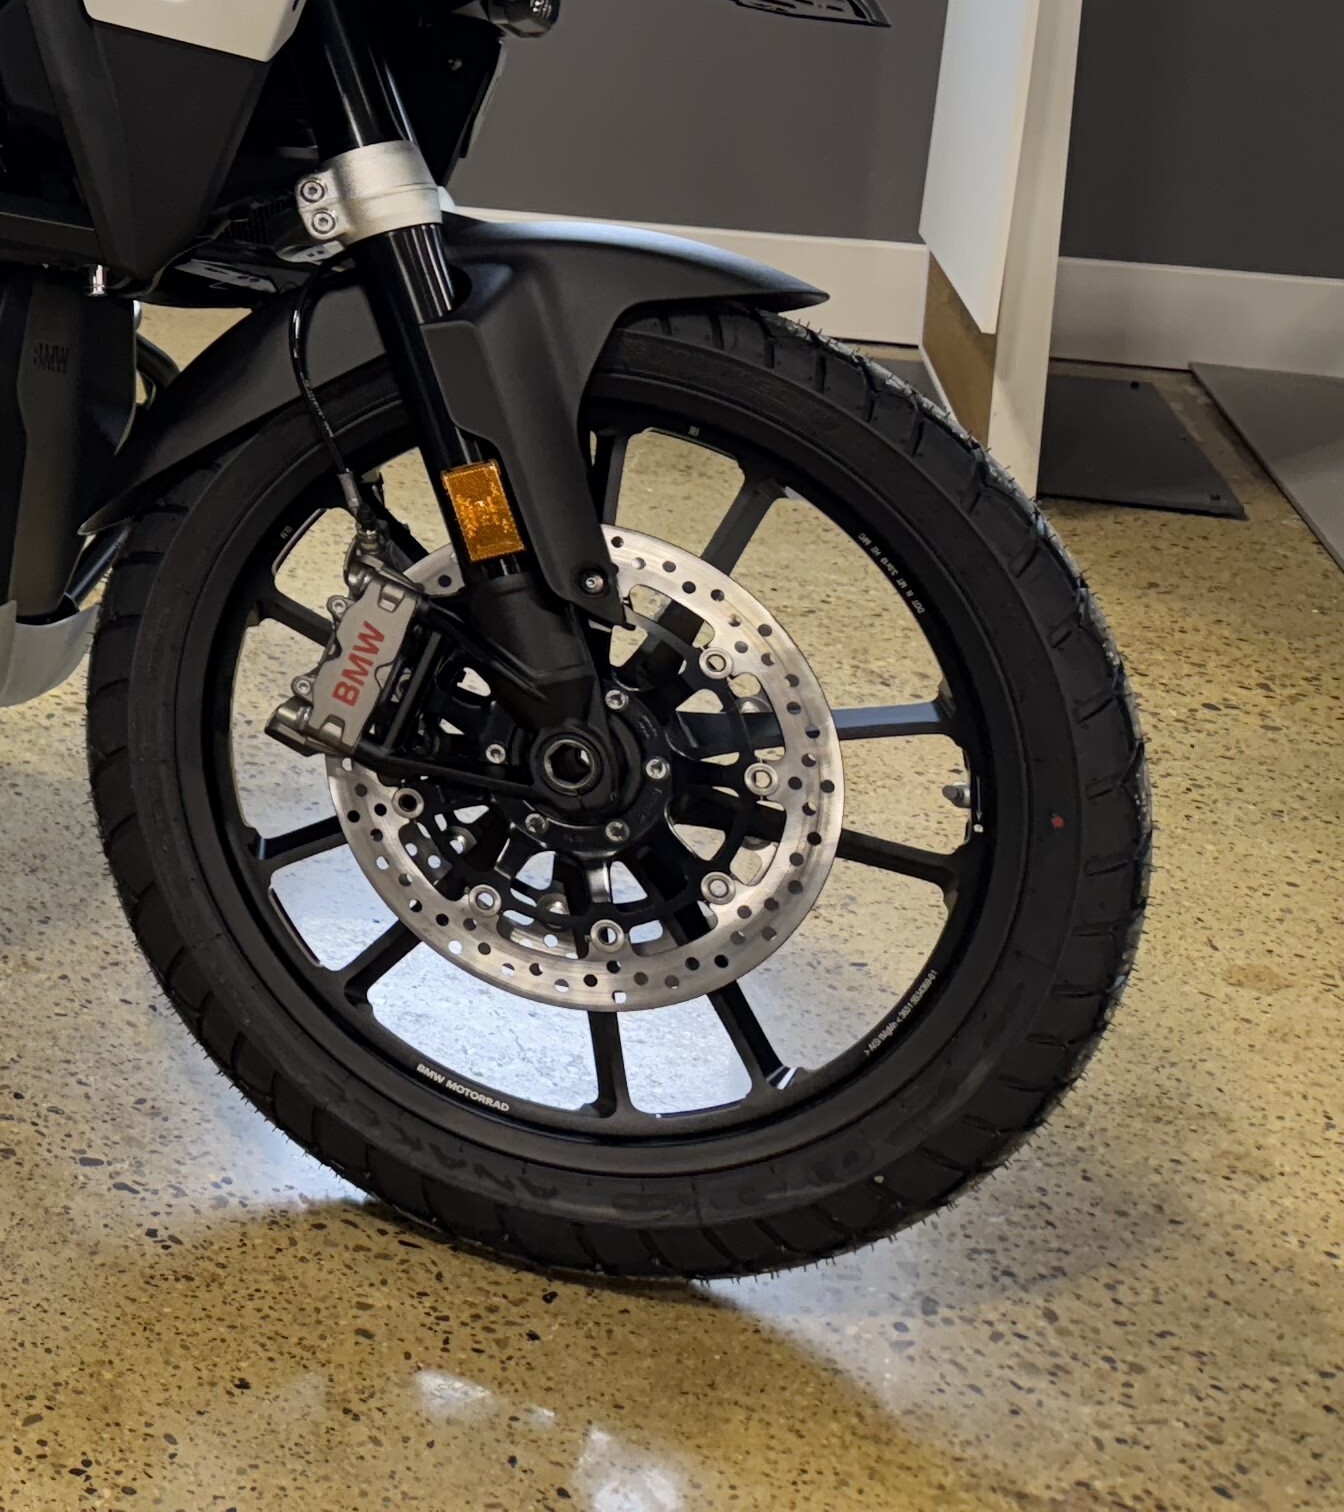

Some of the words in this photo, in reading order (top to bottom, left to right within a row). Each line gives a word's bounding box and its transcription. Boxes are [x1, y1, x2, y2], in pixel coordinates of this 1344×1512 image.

[332, 619, 385, 707] BMW
[416, 1062, 446, 1084] BMW
[445, 1079, 510, 1112] MOTORRAD
